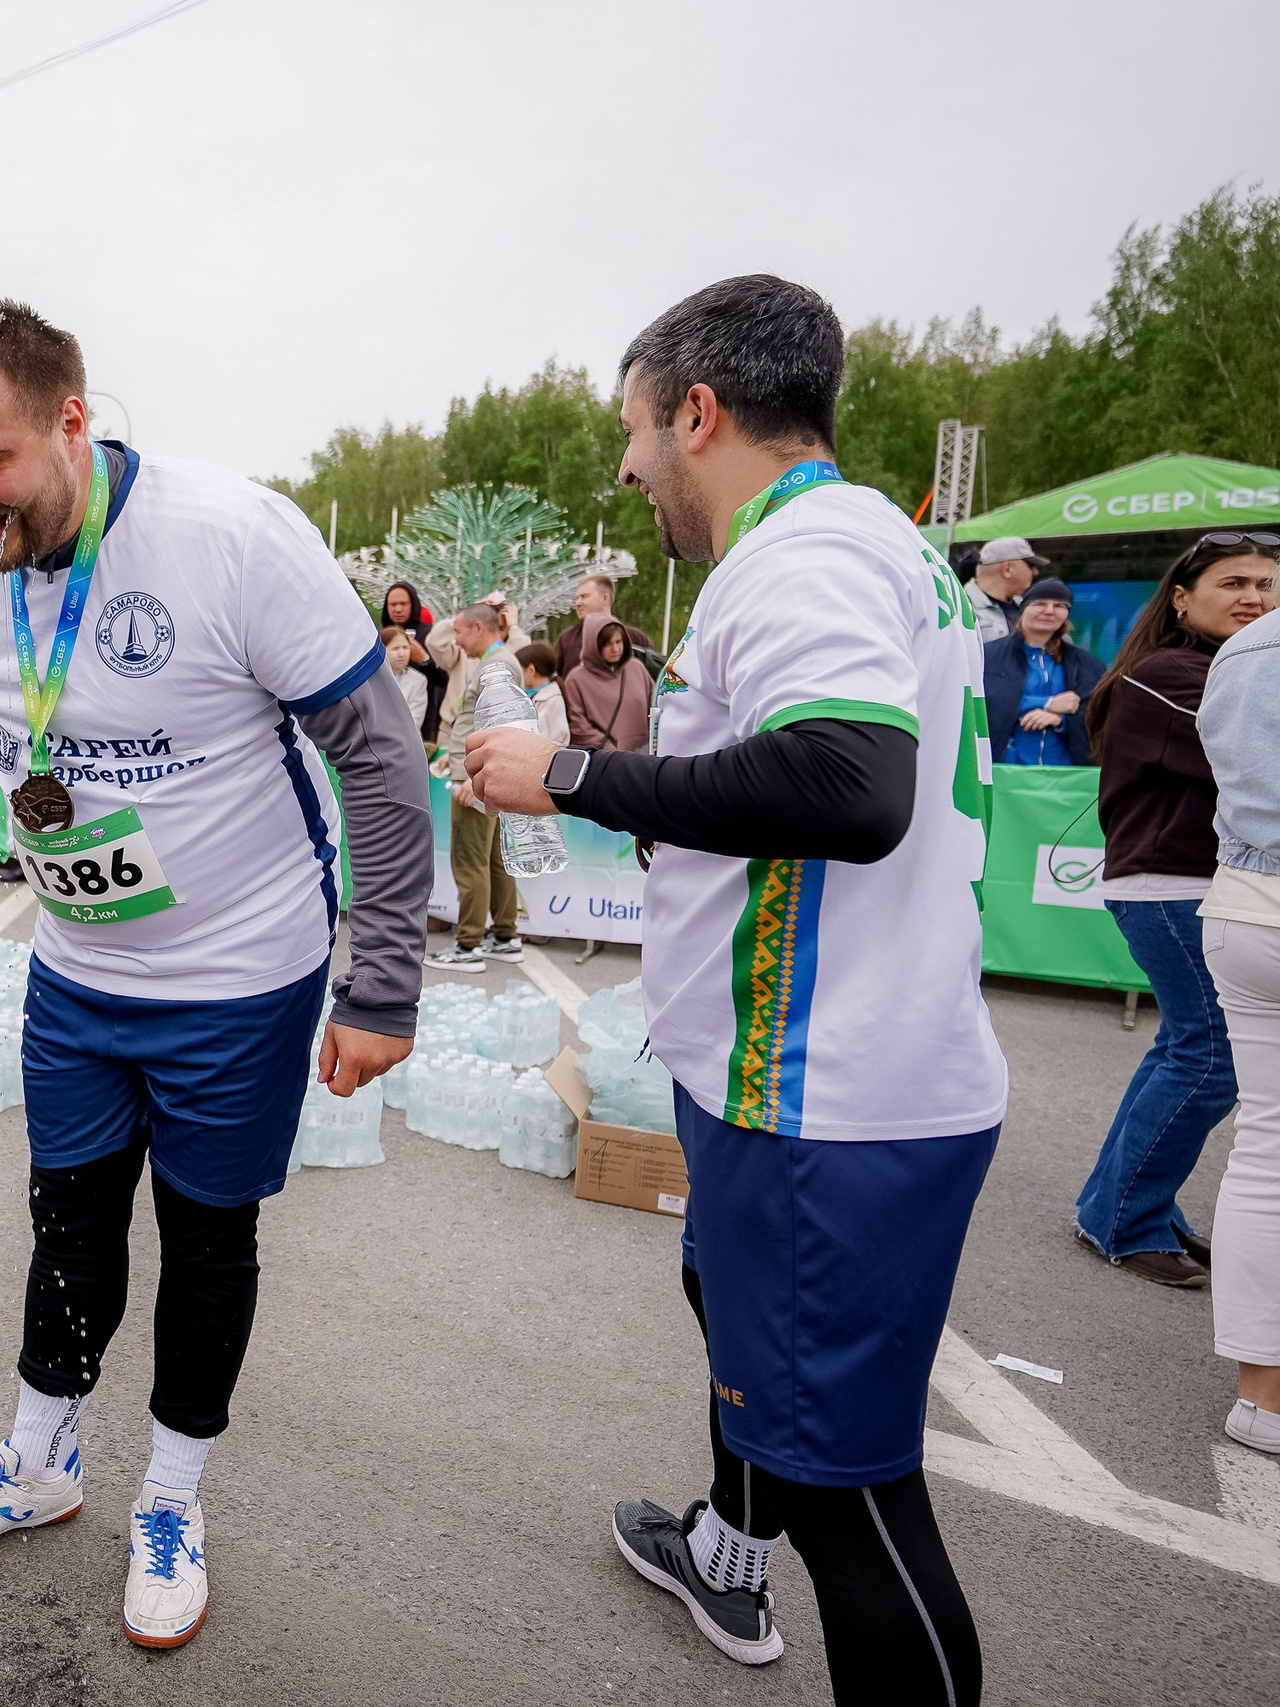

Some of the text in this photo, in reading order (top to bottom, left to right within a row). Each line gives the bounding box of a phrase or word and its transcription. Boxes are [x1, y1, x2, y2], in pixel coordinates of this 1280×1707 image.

[744, 503, 756, 522] лет
[1107, 486, 1280, 516] СБЕР 185
[91, 506, 100, 523] 185
[69, 590, 80, 609] Utair
[105, 596, 162, 620] САМАРОВО
[21, 646, 31, 670] СБЕР
[56, 640, 67, 665] СБЕР
[109, 653, 163, 673] ФУТБОЛЬНЫЙ КЛУБ
[53, 756, 207, 789] арбершо
[25, 847, 143, 897] 1386
[589, 897, 642, 920] Utair
